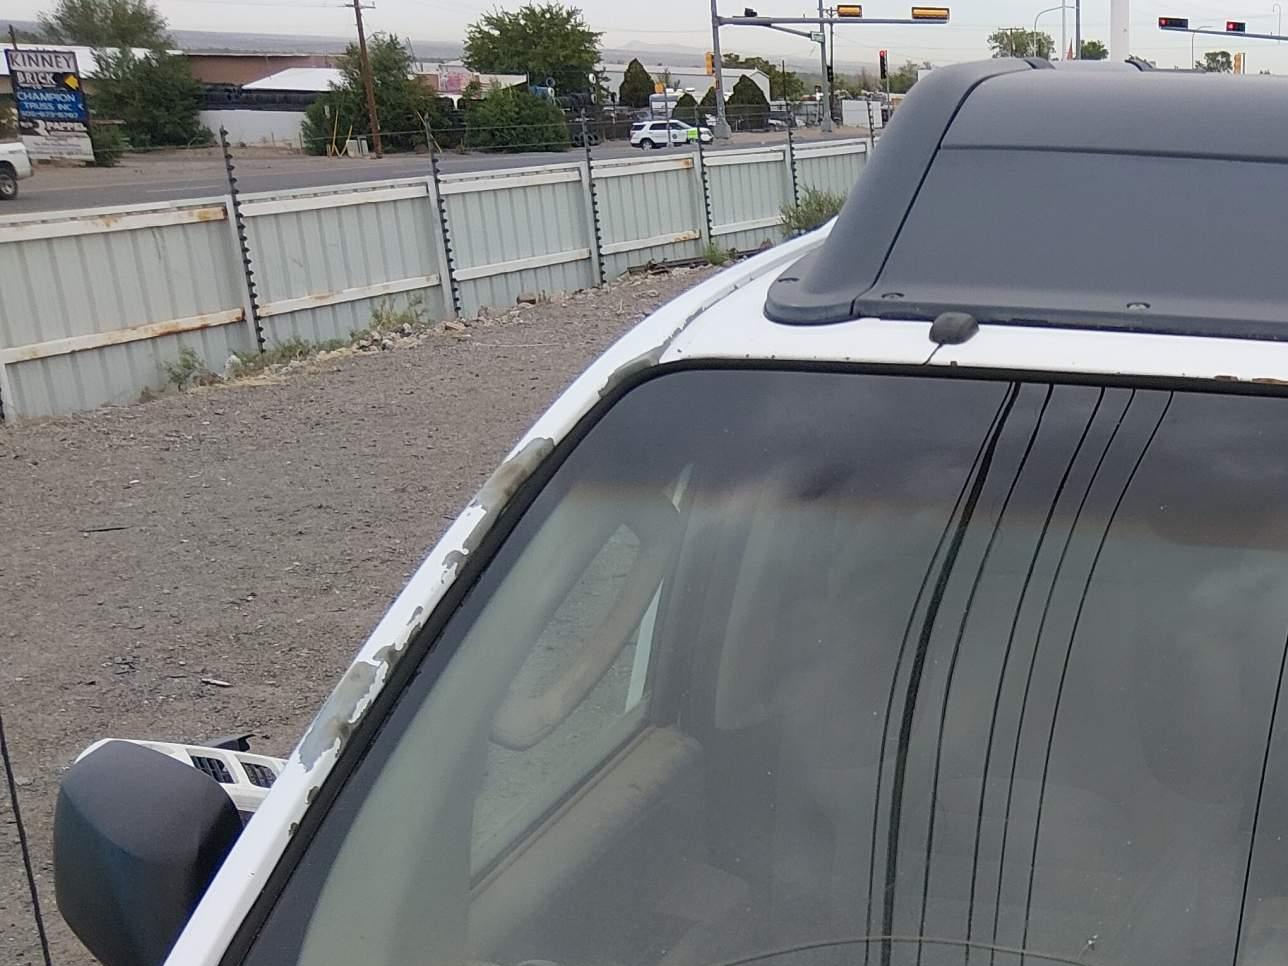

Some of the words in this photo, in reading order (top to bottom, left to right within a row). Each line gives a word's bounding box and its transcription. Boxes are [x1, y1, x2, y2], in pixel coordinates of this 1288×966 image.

[10, 53, 73, 69] KINNEY
[16, 71, 56, 85] BRICK
[17, 91, 76, 102] CHAMPION
